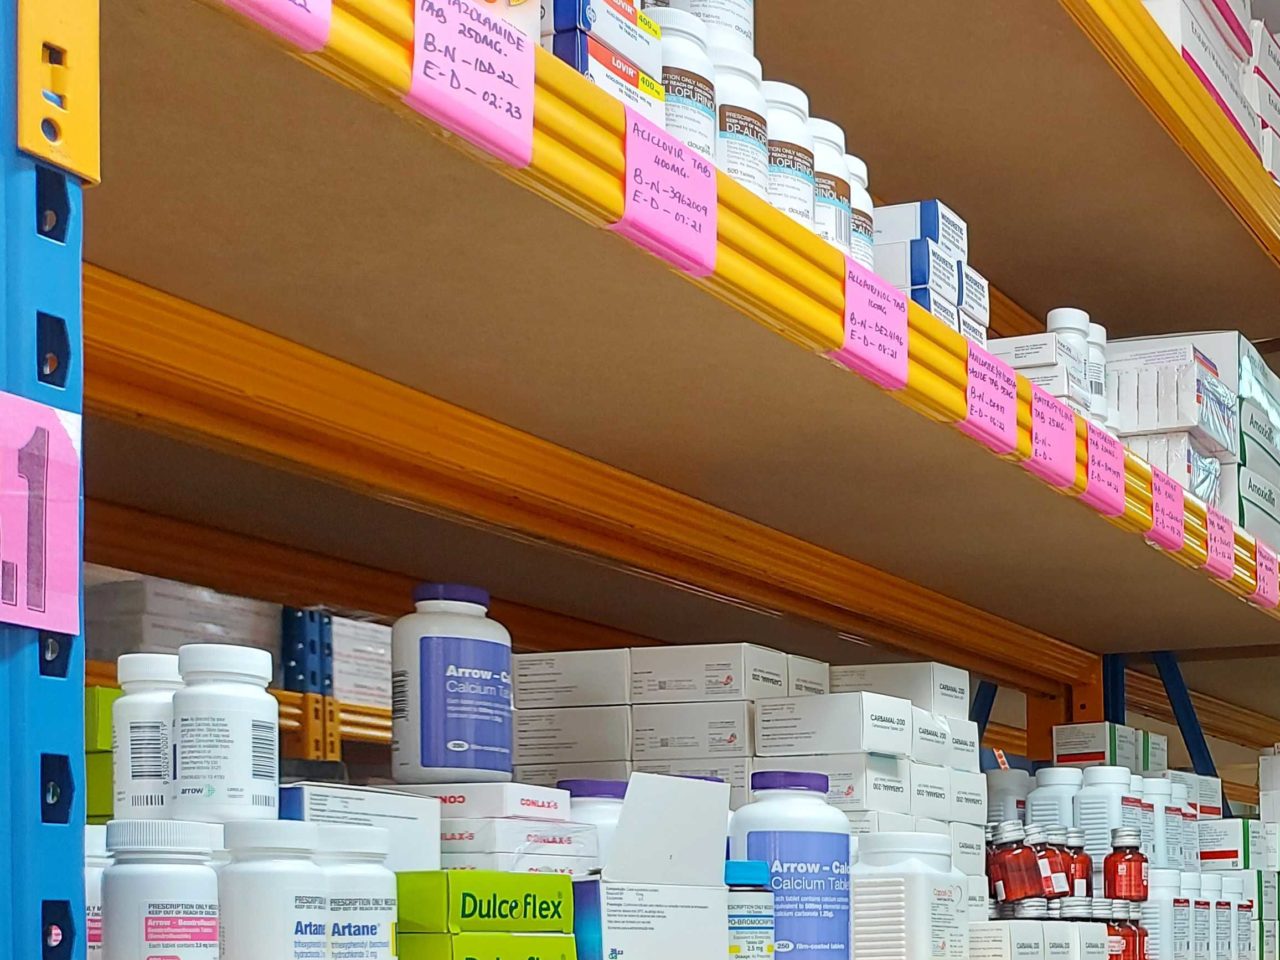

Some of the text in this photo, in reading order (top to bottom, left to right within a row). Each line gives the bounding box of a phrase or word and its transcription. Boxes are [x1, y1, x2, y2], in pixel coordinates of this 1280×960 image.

[633, 122, 712, 178] ACICLOVIR TAB
[446, 665, 492, 679] Arrow
[446, 680, 495, 695] Calcium
[771, 859, 819, 874] Arrow
[771, 875, 822, 891] Calcium
[331, 922, 377, 937] Artane
